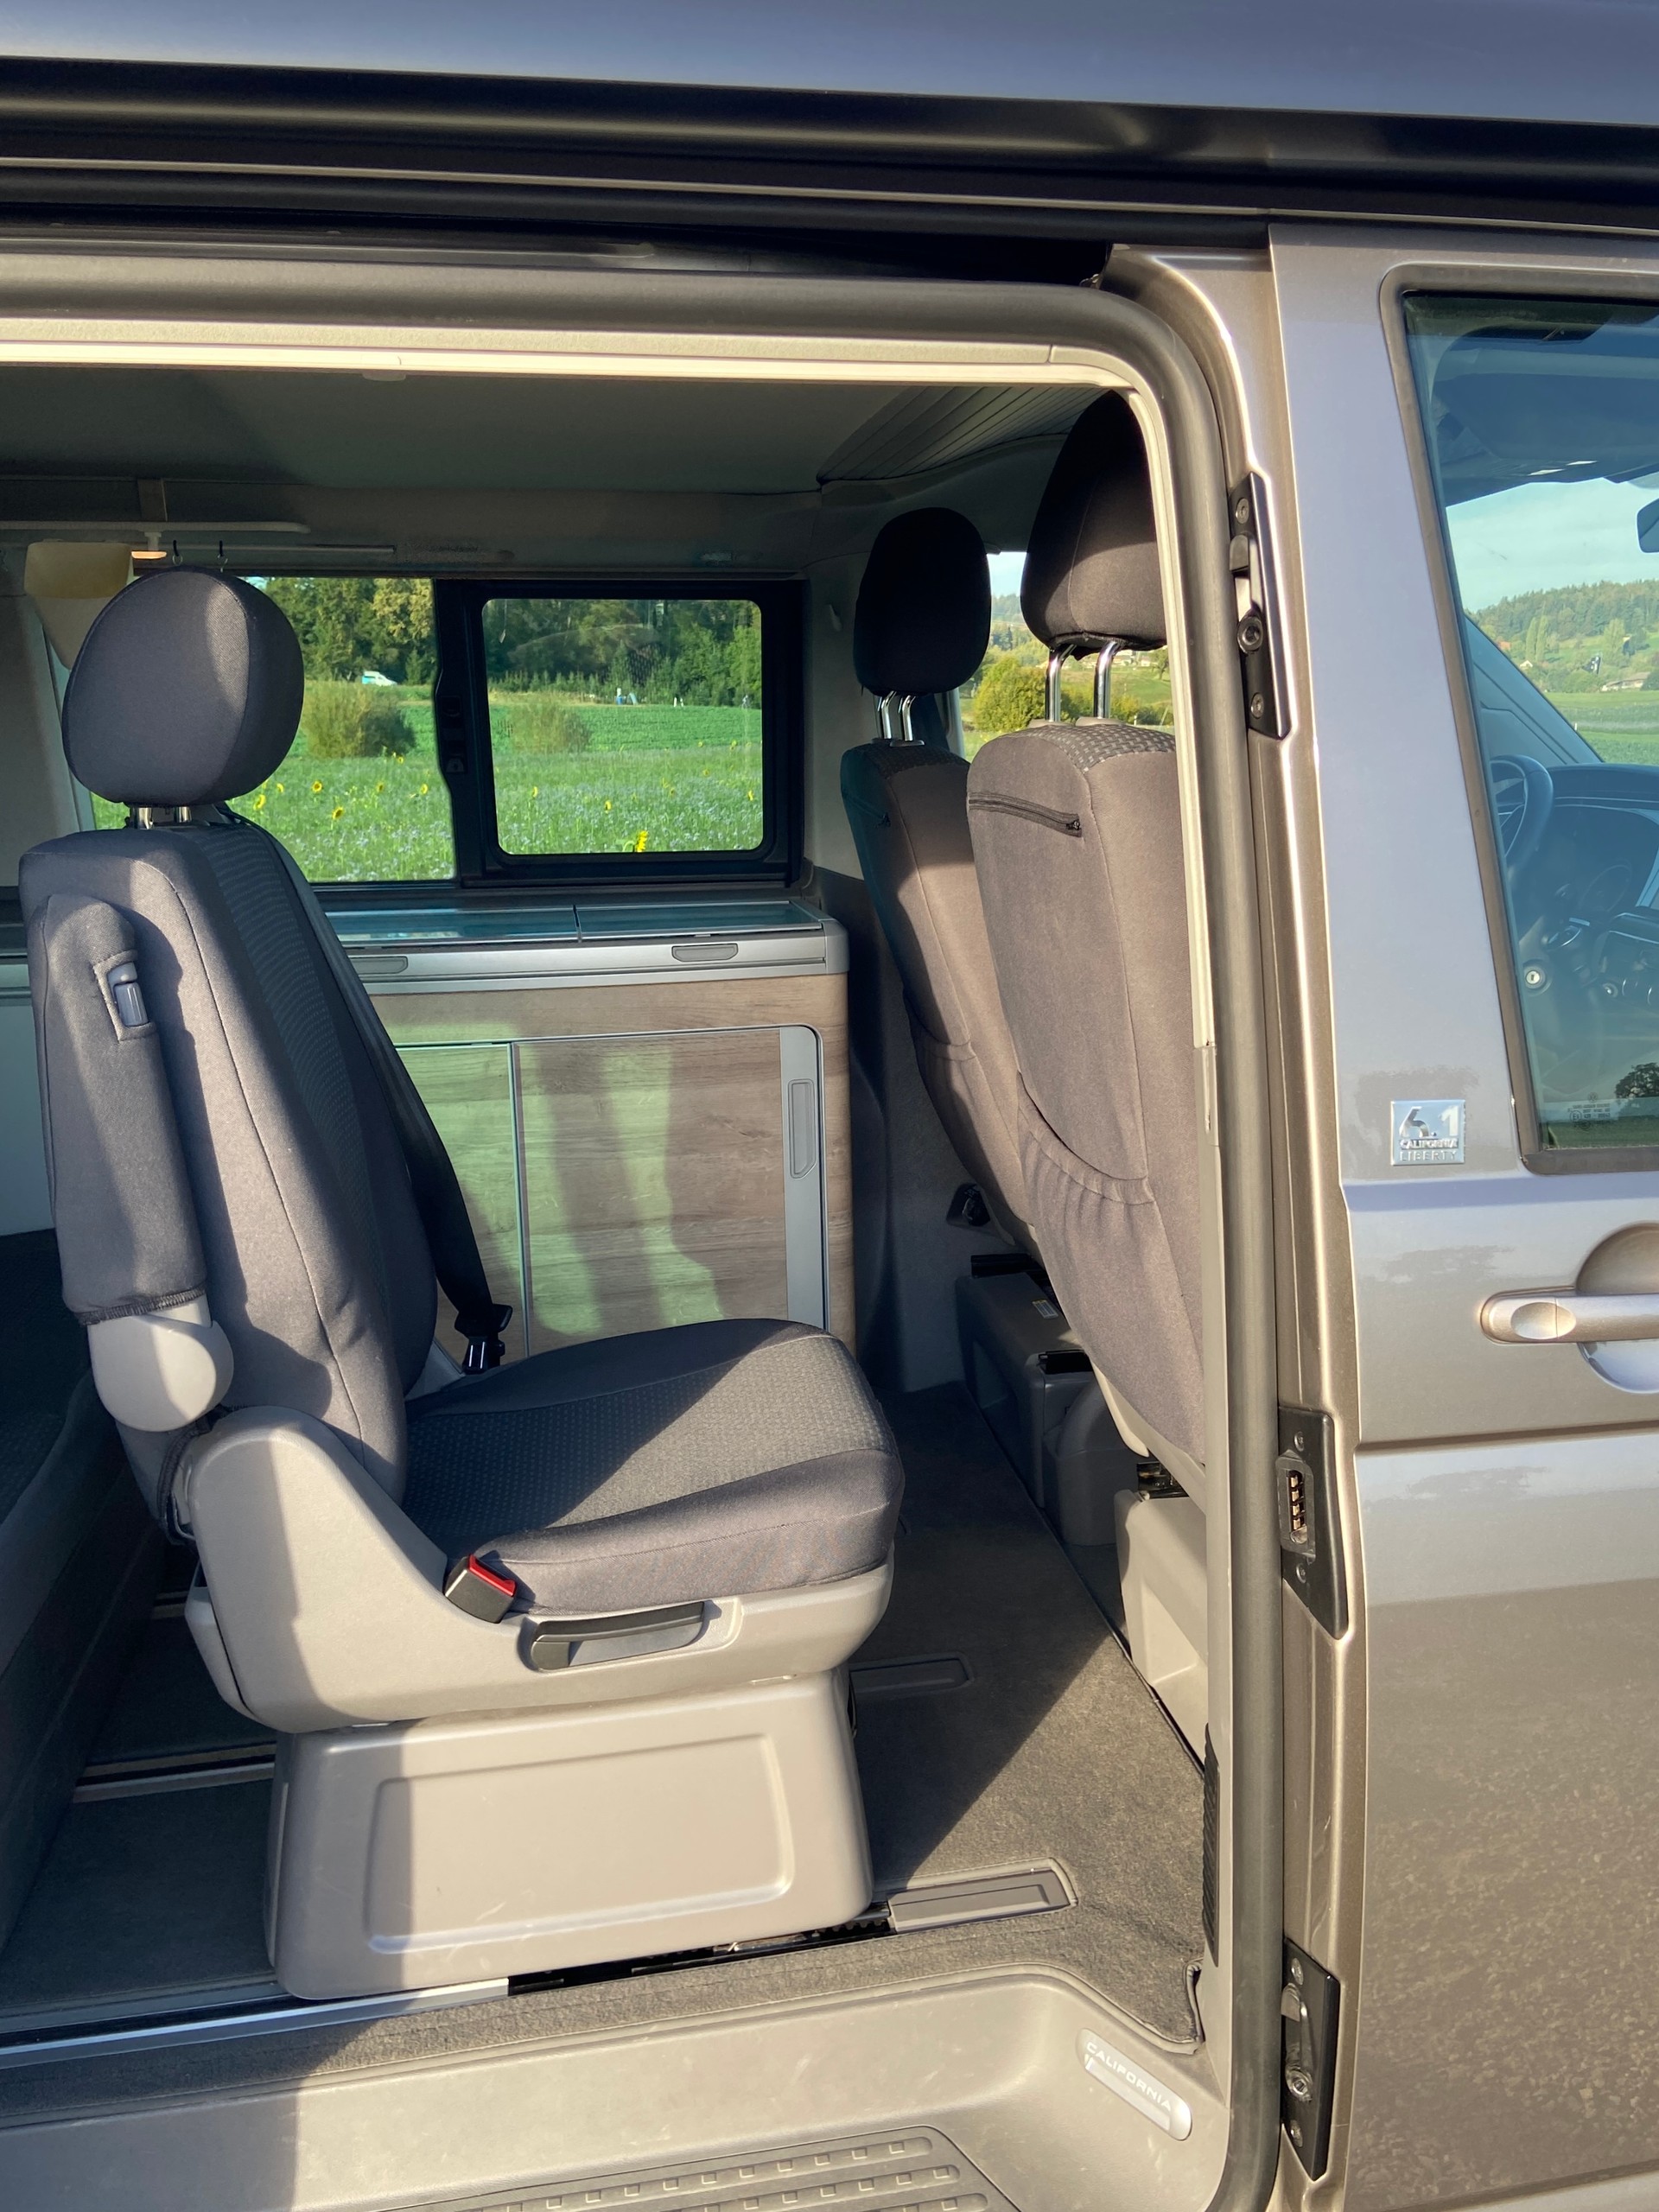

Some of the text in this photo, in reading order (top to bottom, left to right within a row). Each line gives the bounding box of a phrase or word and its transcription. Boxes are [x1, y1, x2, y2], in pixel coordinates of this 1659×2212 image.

[1399, 1106, 1459, 1138] 6.1
[1400, 1138, 1458, 1149] CALIFORNIA
[1400, 1150, 1457, 1161] LIBERTY
[1086, 2041, 1172, 2112] CALIFORNIA
